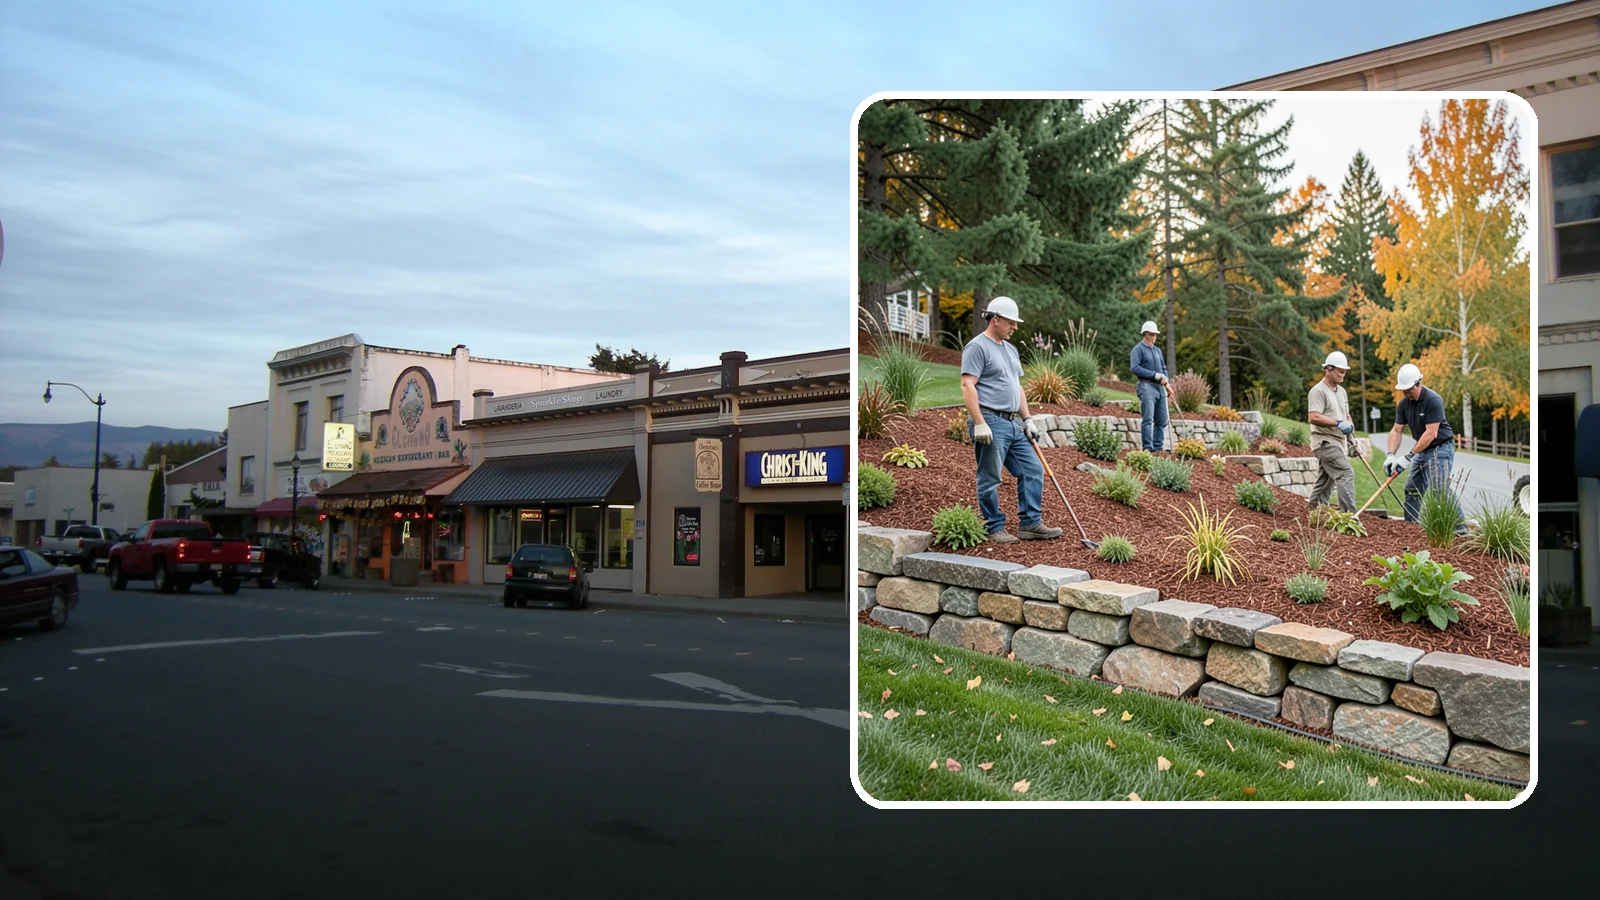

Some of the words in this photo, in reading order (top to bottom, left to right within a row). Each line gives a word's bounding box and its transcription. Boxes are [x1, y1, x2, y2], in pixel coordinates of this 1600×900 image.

[530, 396, 561, 409] Sparkle
[561, 394, 582, 405] Shop
[595, 389, 623, 400] LAUNDRY
[493, 402, 523, 413] LAVANDERIA
[373, 454, 396, 464] MEXICAN
[397, 451, 433, 462] RESTAURANT
[438, 450, 450, 458] BAR
[760, 452, 797, 478] CHRIST
[799, 450, 828, 476] KING
